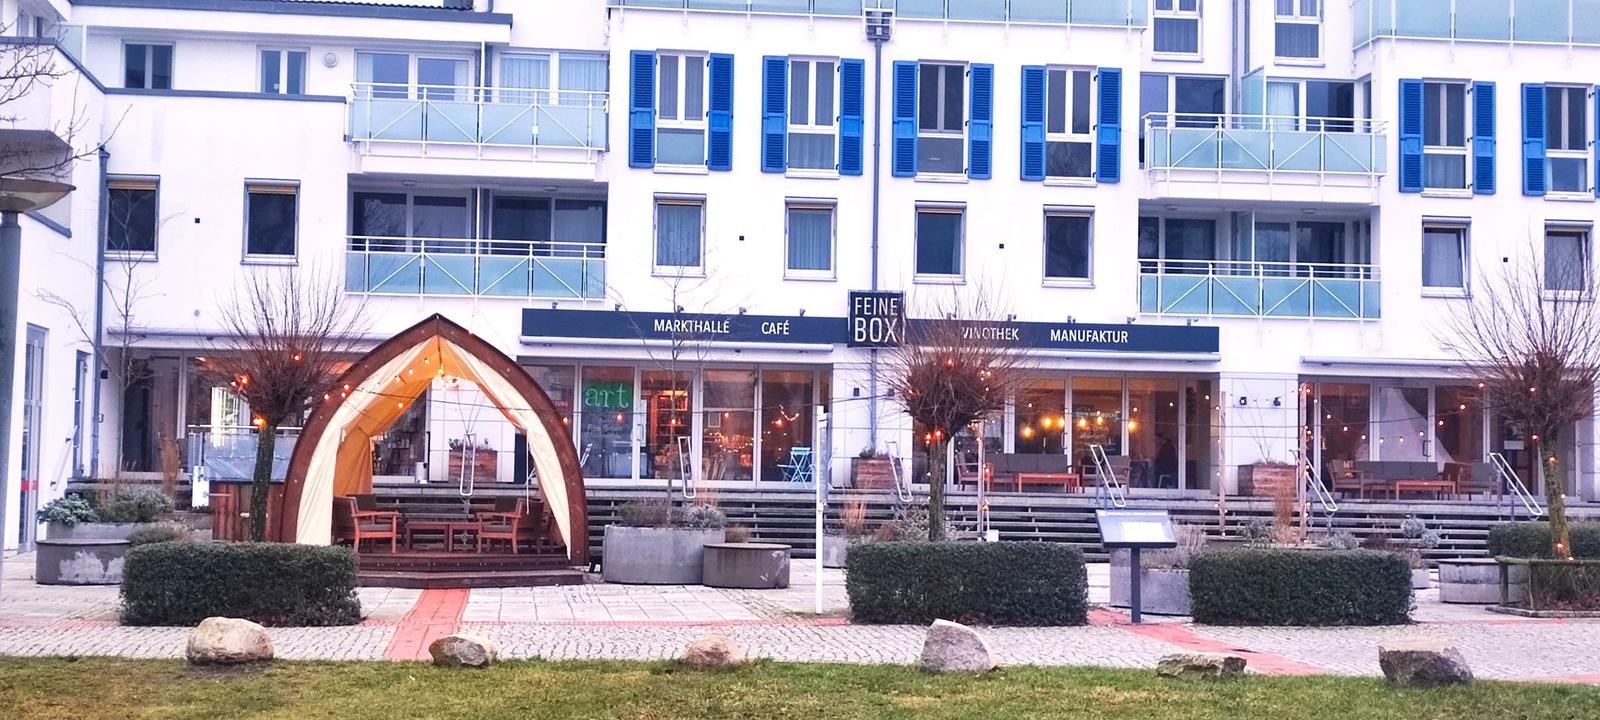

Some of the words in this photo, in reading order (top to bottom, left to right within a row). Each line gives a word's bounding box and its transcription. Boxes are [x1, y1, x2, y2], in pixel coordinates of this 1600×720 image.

[855, 297, 898, 316] FEINE
[654, 319, 730, 334] MARKTHALLE
[761, 320, 790, 335] CAFÉ
[855, 317, 898, 343] BOX
[962, 327, 1020, 341] VINOTHEK
[1050, 329, 1129, 343] MANUFAKTUR
[585, 383, 629, 408] art
